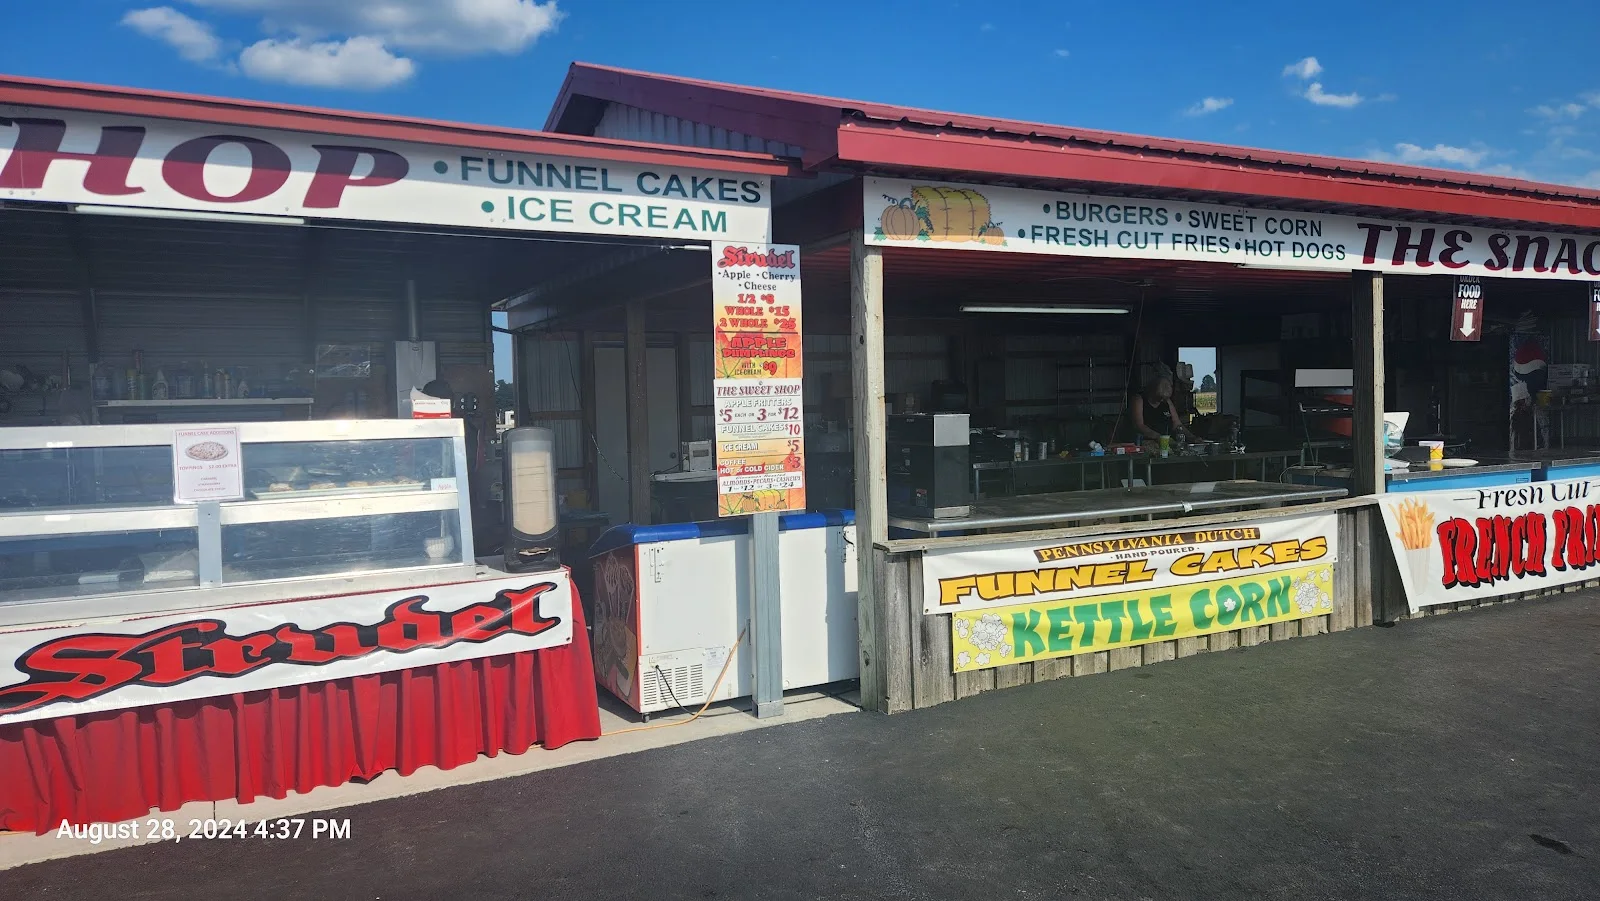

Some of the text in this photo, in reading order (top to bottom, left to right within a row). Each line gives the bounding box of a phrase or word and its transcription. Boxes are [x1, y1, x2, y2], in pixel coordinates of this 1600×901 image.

[461, 156, 761, 203] FUNNEL CAKES
[508, 196, 726, 233] ICE CREAM
[1056, 201, 1322, 238] BURGERS SWEET CORN
[1031, 225, 1346, 261] FRESH CUT FRIES HOT DOGS
[1357, 222, 1473, 269] THE
[717, 245, 796, 269] Strudel
[722, 270, 795, 282] Apple Cherry
[744, 281, 777, 291] Cheese
[1458, 284, 1481, 299] FOOD
[737, 294, 775, 304] 1/2 $8
[1461, 299, 1478, 309] HERE
[724, 305, 790, 317] WHOLE $15
[720, 317, 797, 330] 2 WHOLE $25
[730, 337, 786, 348] APPLE
[722, 348, 795, 358] DUMPLINGS
[763, 361, 778, 375] $9
[716, 384, 801, 396] THE SWEET SHOP
[724, 398, 792, 408] APPLE FRITTERS
[719, 408, 733, 422] $5
[757, 408, 767, 421] 3
[778, 407, 799, 420] $12
[721, 423, 801, 435] FUNNEL CAKES $10
[722, 440, 800, 452] ICE CREAM $5
[744, 465, 763, 473] COLD
[788, 456, 801, 469] $3
[1476, 485, 1545, 510] Fresh
[1039, 528, 1257, 562] PENNSYLVANIA DUTCH
[1436, 511, 1548, 590] FRENCH
[938, 536, 1328, 606] FUNNEL CAKES
[1012, 575, 1292, 658] KETTLE CORN
[0, 581, 561, 715] Strudel
